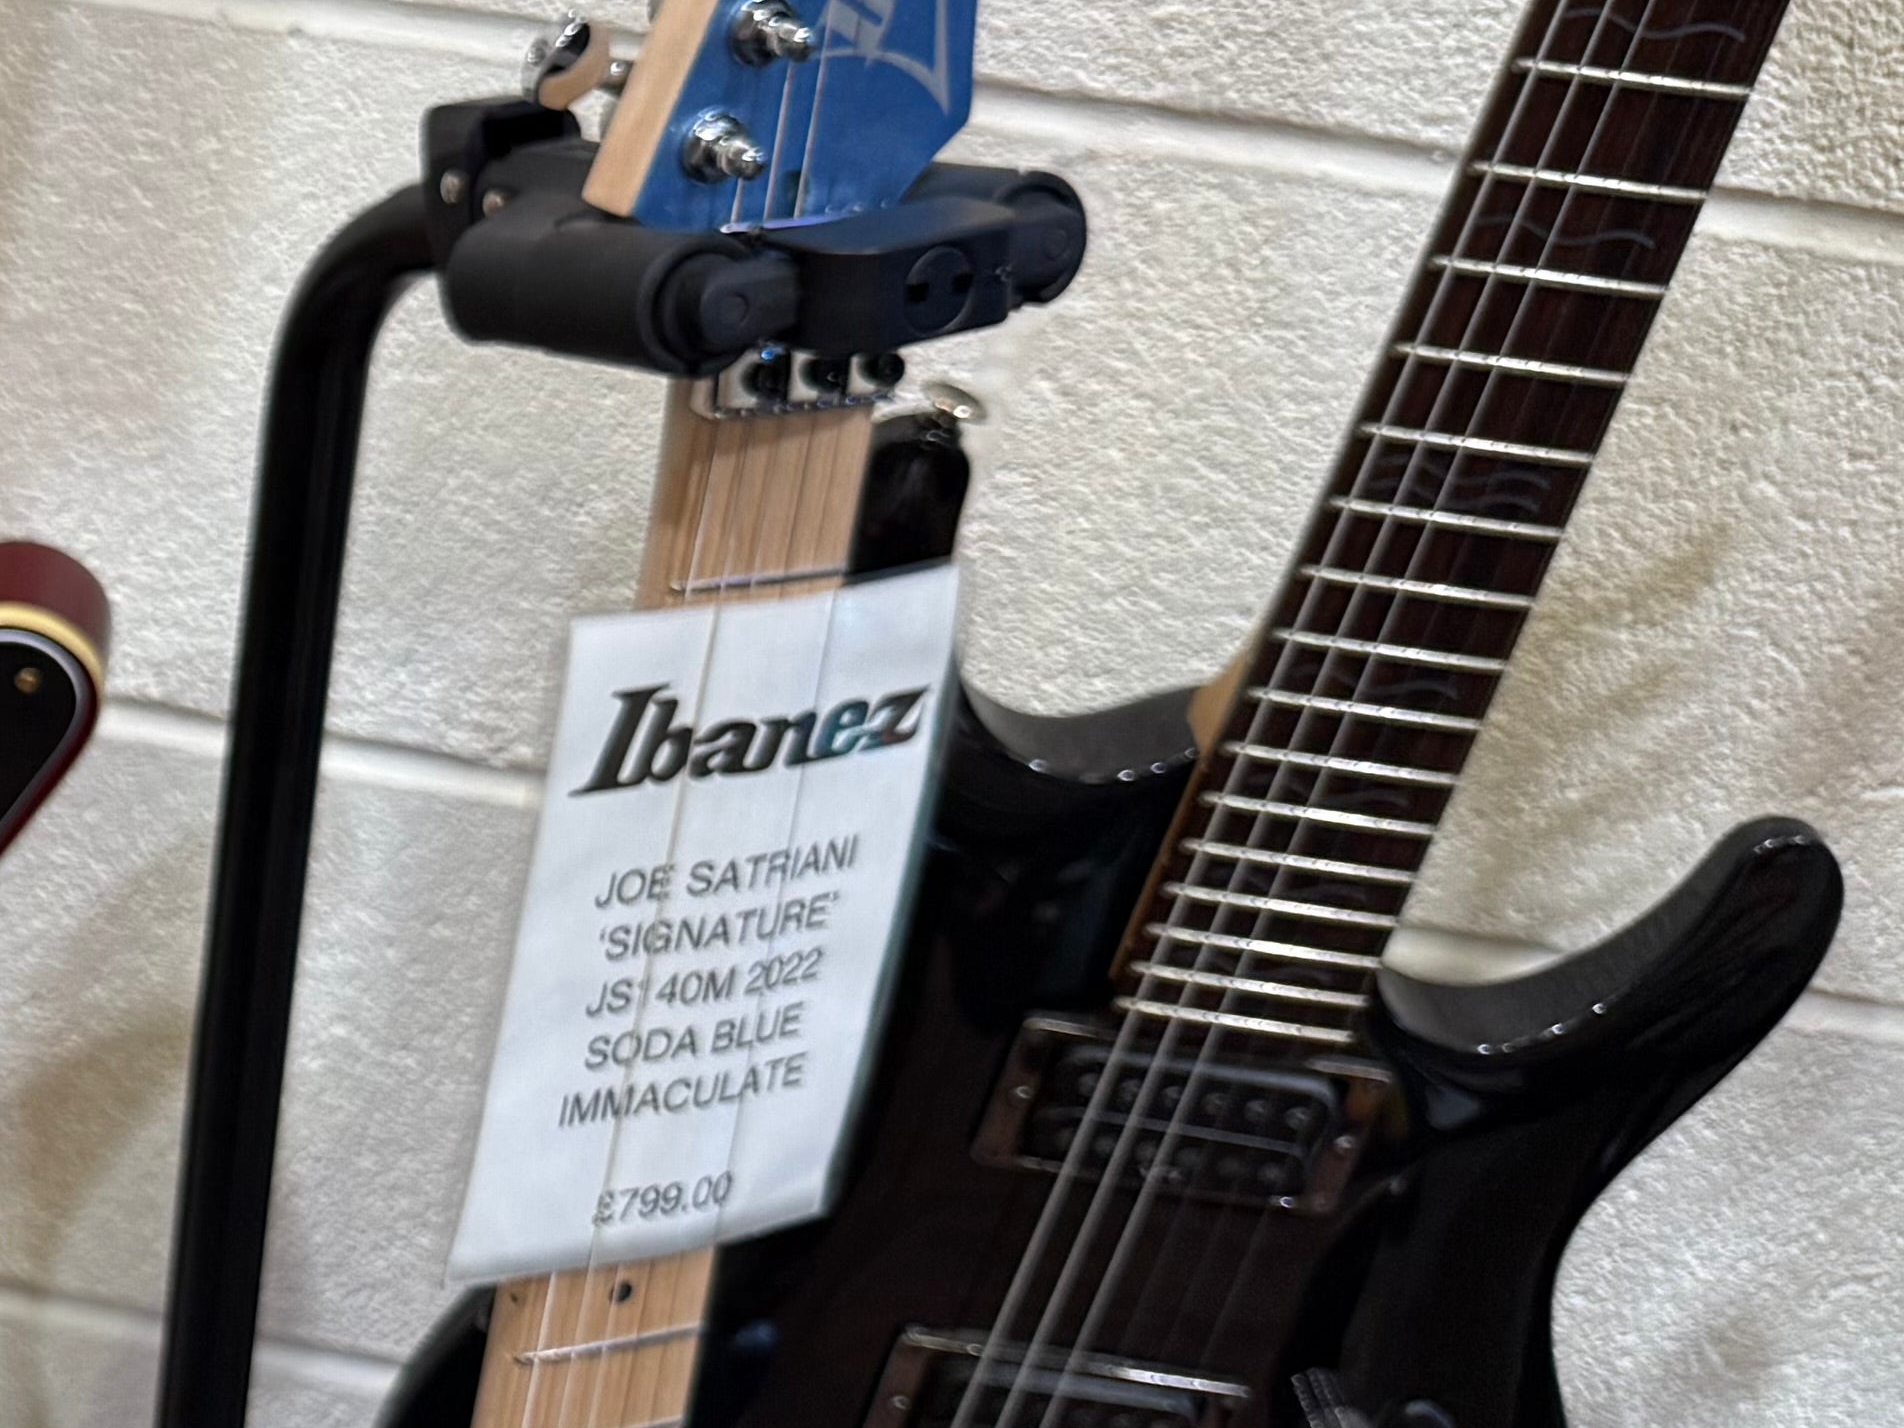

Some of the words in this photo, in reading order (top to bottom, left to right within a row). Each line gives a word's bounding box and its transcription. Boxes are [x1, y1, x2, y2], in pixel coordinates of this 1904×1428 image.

[567, 682, 931, 798] Ibanez
[594, 863, 675, 911] JOE
[686, 834, 859, 895] SATRIANI
[745, 946, 824, 997] 2022
[583, 1024, 698, 1072] SODA
[710, 1000, 805, 1055] BLUE
[558, 1052, 807, 1129] IMMACULATE
[591, 1169, 734, 1227] £799.00
